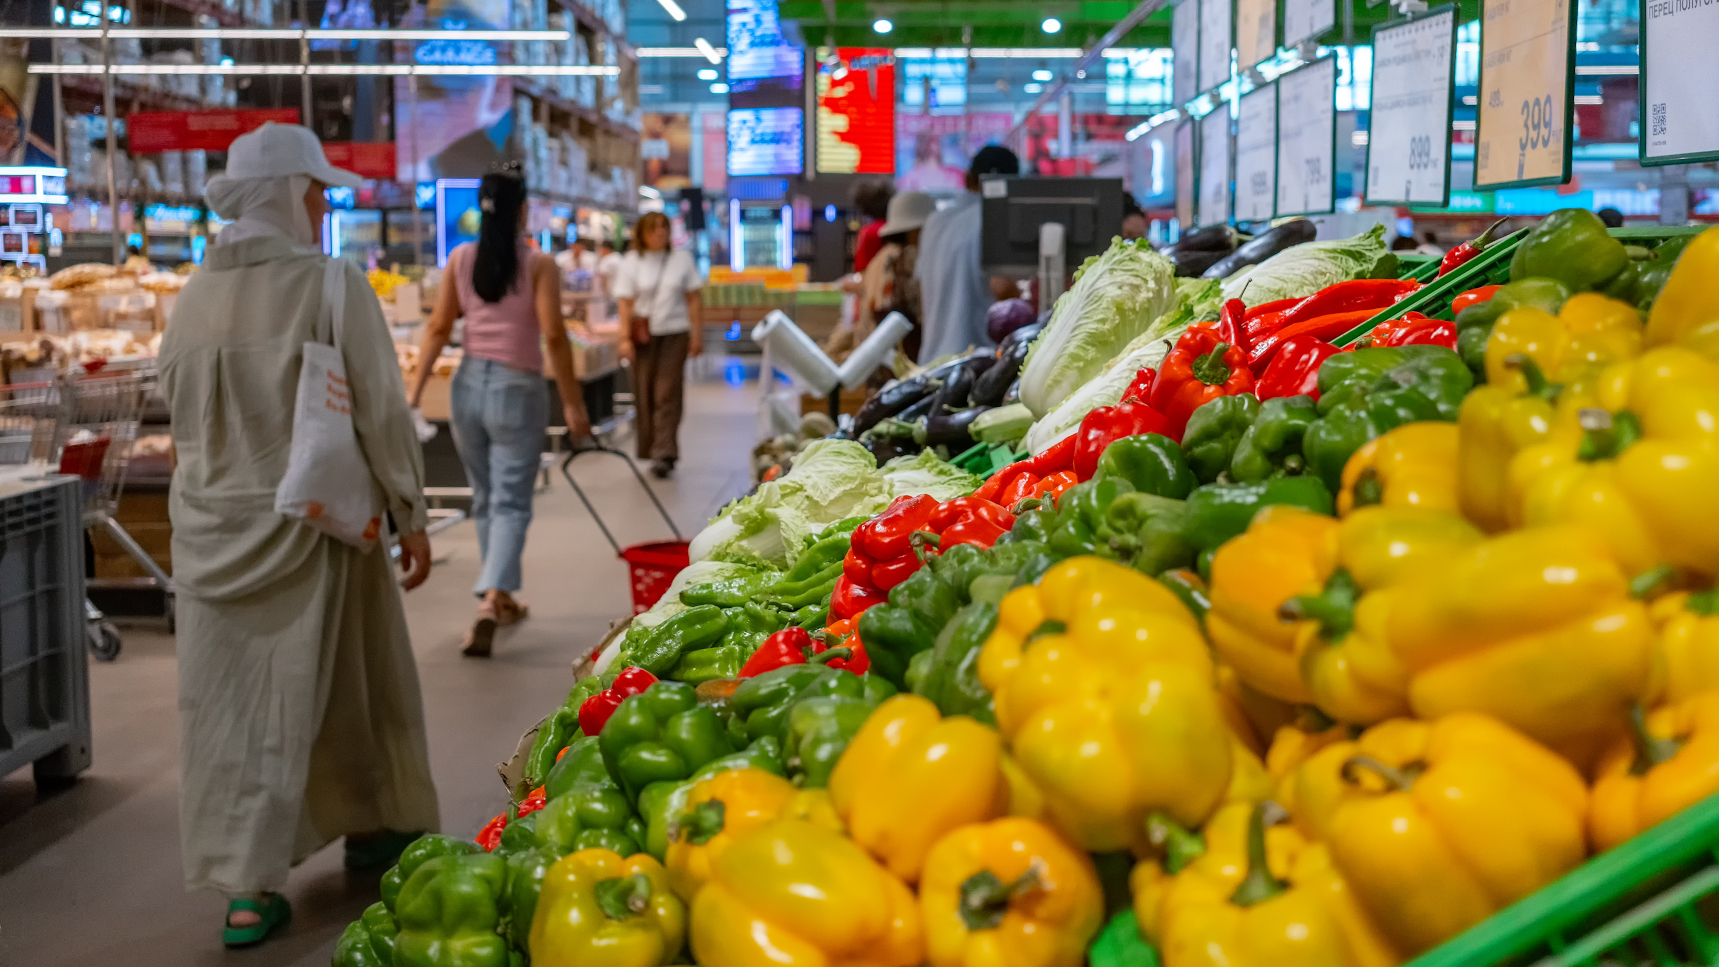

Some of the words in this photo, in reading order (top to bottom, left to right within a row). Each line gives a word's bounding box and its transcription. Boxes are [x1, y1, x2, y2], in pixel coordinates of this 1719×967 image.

[1649, 1, 1674, 19] ПЕРЕЦ
[1675, 0, 1719, 13] ПОЛУ
[1519, 93, 1552, 152] 399
[1409, 134, 1431, 170] 899
